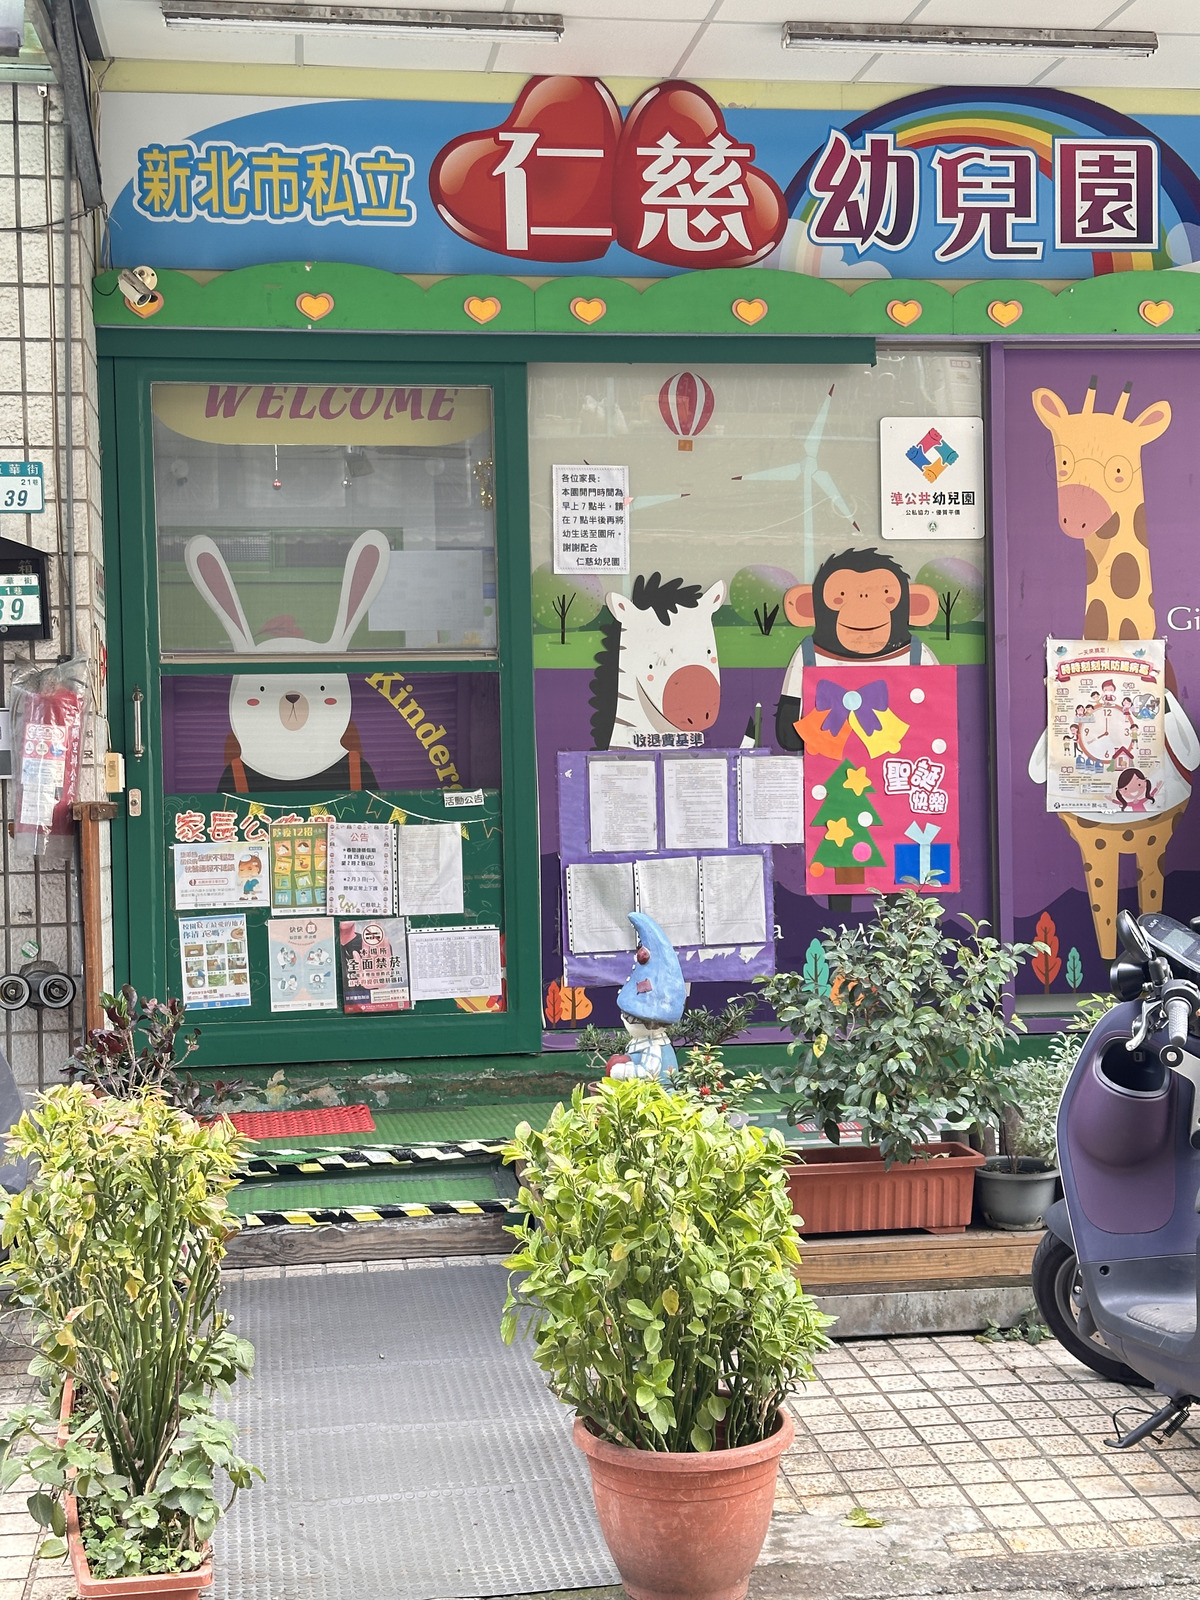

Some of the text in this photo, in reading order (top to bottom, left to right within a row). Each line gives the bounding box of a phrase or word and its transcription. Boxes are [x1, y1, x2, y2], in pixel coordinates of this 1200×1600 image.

[139, 128, 1162, 261] 新北市私立 仁慈 幼兒園
[204, 385, 459, 421] WELCOME
[0, 464, 38, 475] 華街
[5, 490, 28, 507] 39
[562, 488, 623, 497] 本園開門時間為
[891, 491, 976, 506] 準公共幼兒園
[563, 543, 598, 553] 謝謝配合
[576, 557, 620, 567] 仁慈幼兒園
[1103, 709, 1112, 717] 12
[365, 673, 463, 790] Kinder
[633, 733, 703, 747] 收退費基準
[886, 759, 943, 792] 聖誕
[445, 794, 483, 806] 活動公告
[911, 790, 947, 813] 快樂
[175, 811, 336, 842] 家長公
[350, 832, 369, 842] 公告
[348, 956, 401, 971] 全面禁菸
